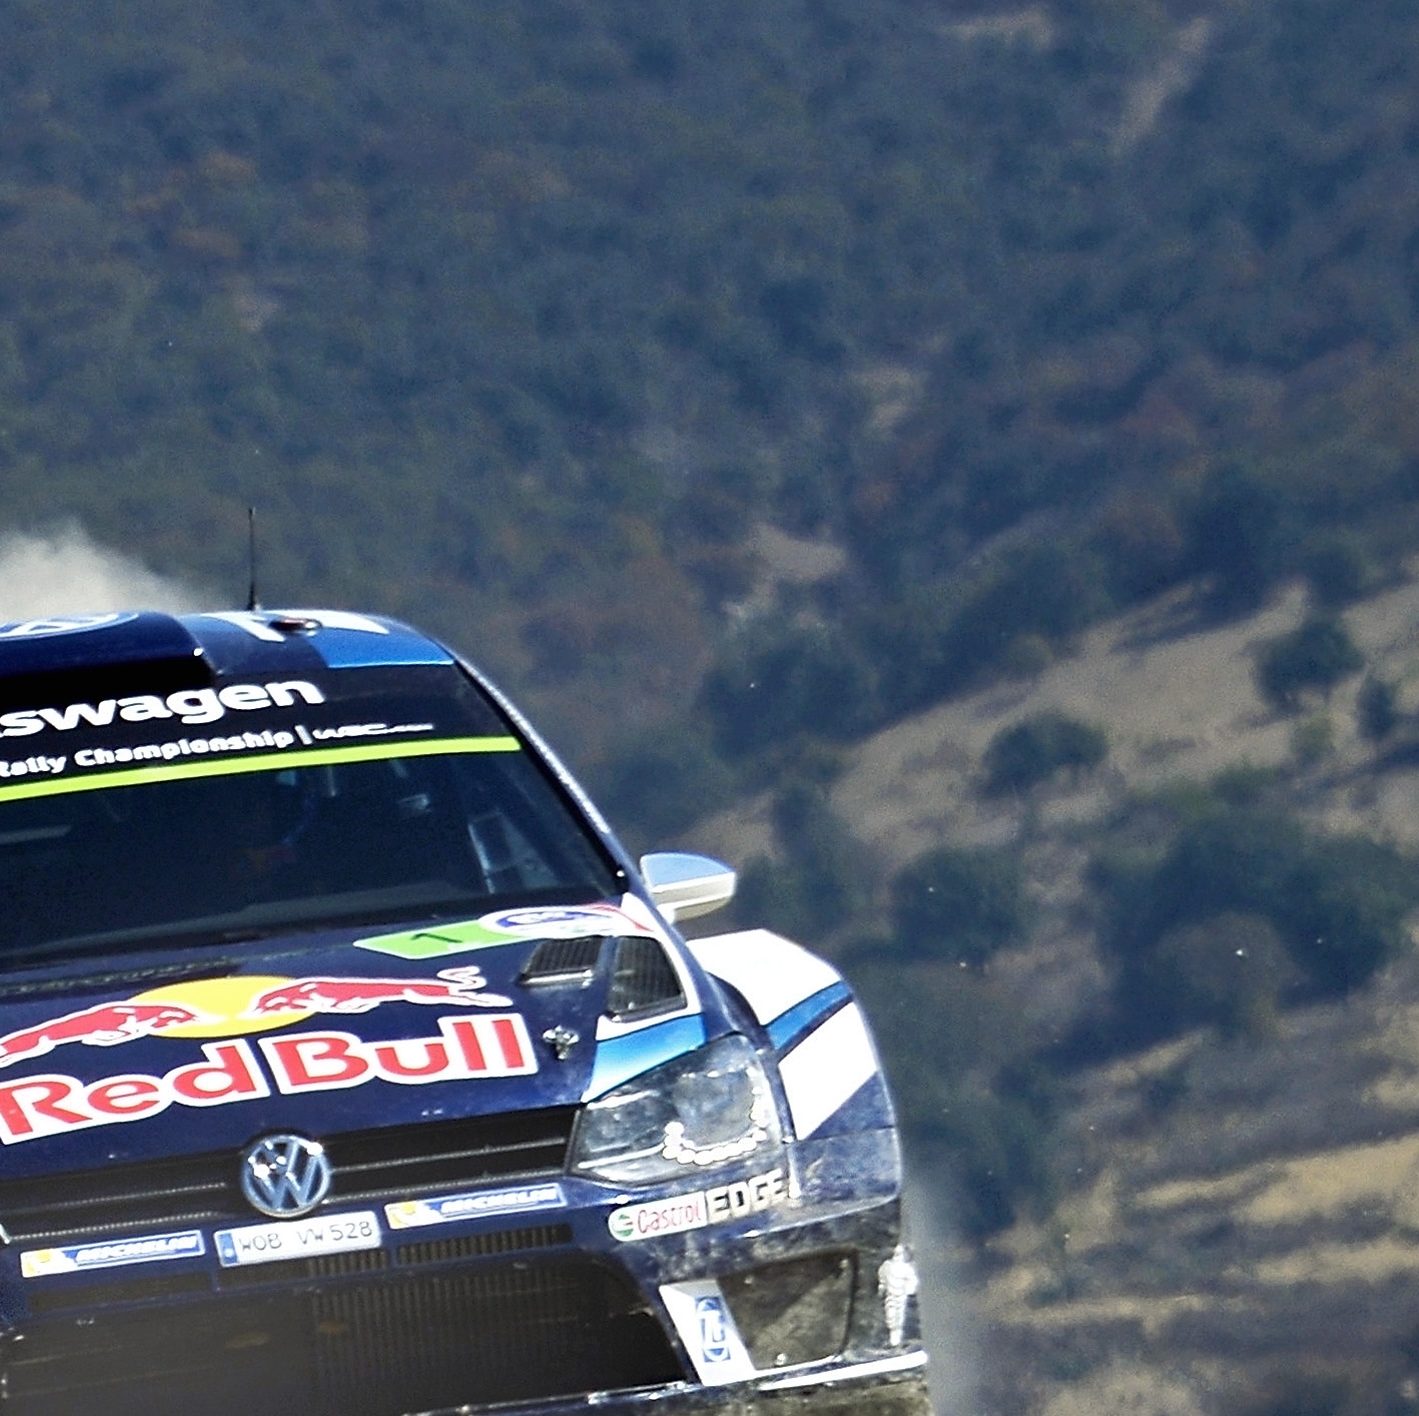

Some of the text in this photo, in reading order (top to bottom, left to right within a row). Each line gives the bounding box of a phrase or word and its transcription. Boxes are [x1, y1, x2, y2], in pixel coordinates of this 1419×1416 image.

[74, 729, 294, 767] Championship
[270, 1018, 525, 1087] Bull
[637, 1168, 787, 1234] Castrol EDGE
